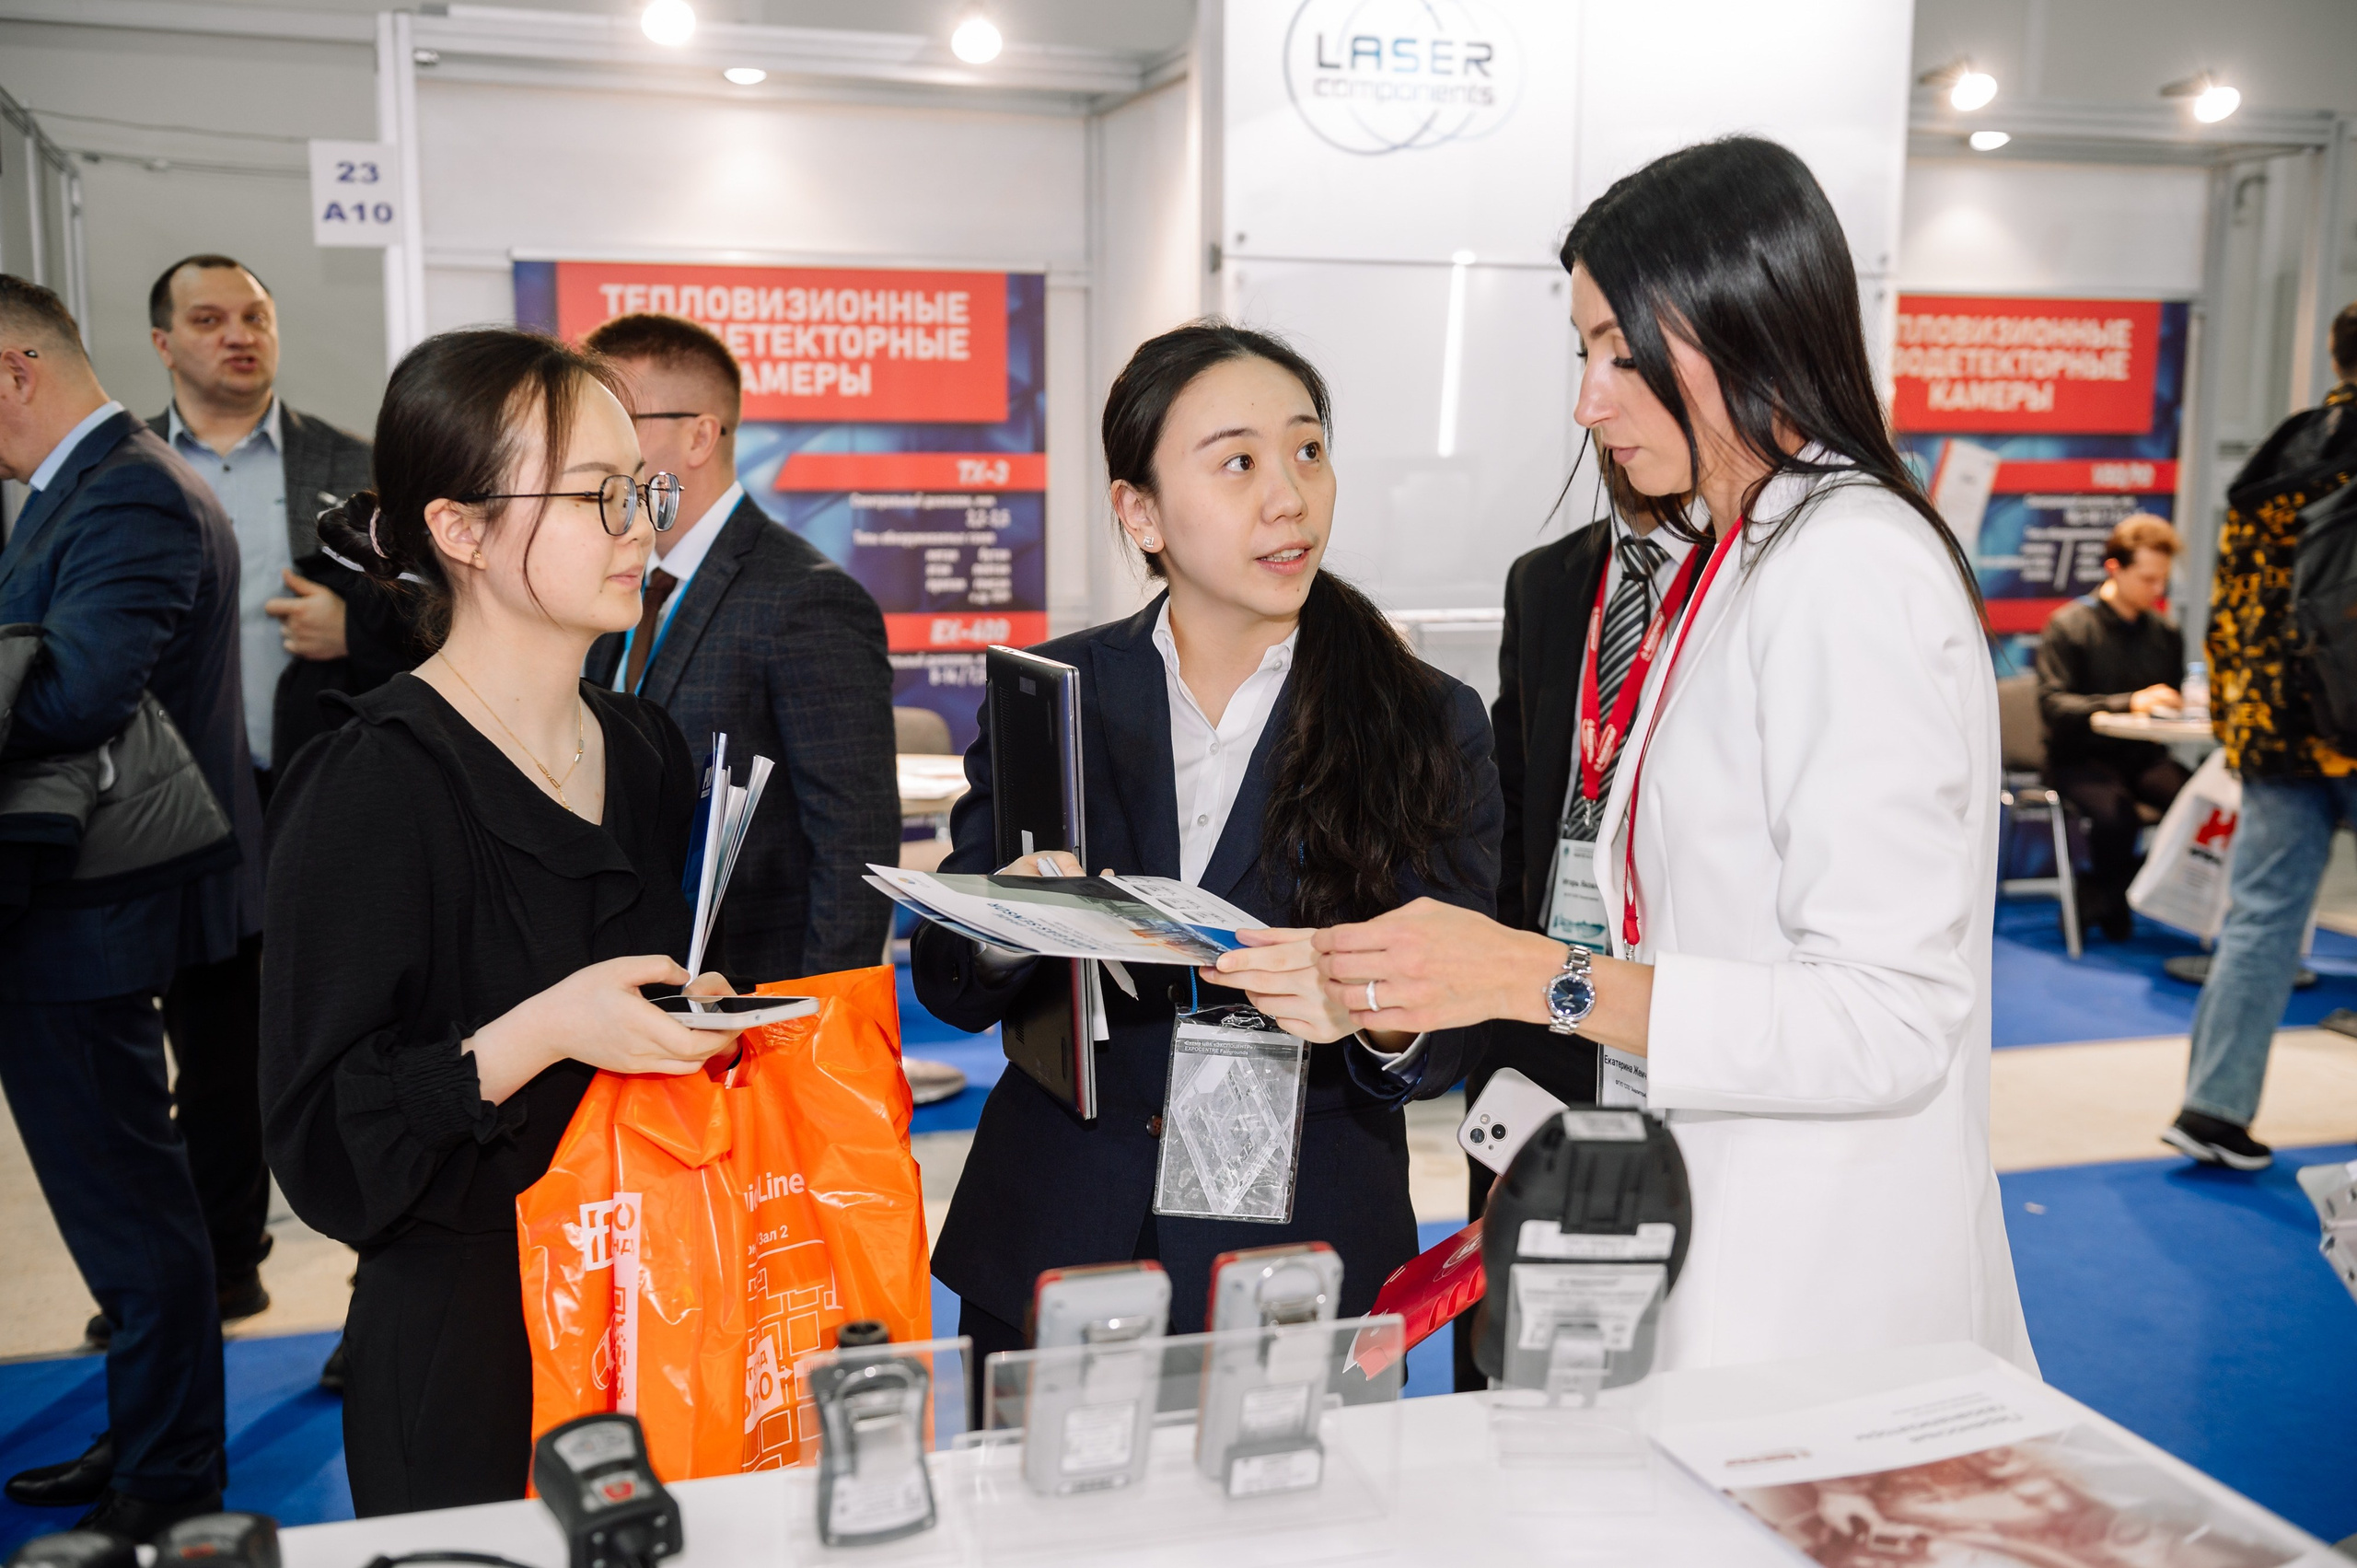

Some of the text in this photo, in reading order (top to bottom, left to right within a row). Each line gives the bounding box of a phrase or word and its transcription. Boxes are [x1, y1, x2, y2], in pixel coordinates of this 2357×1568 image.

[1318, 32, 1493, 77] LASER
[1313, 78, 1494, 105] components
[336, 160, 380, 183] 23
[322, 201, 393, 224] A10
[599, 284, 970, 324] ТЕПЛОВИЗИОННЫЕ
[711, 322, 970, 360] ЕТЕКТОРНЫЕ
[1928, 380, 2055, 412] КАМЕРЫ
[1604, 1054, 1633, 1074] Екатерина
[758, 1225, 789, 1246] Зал 2
